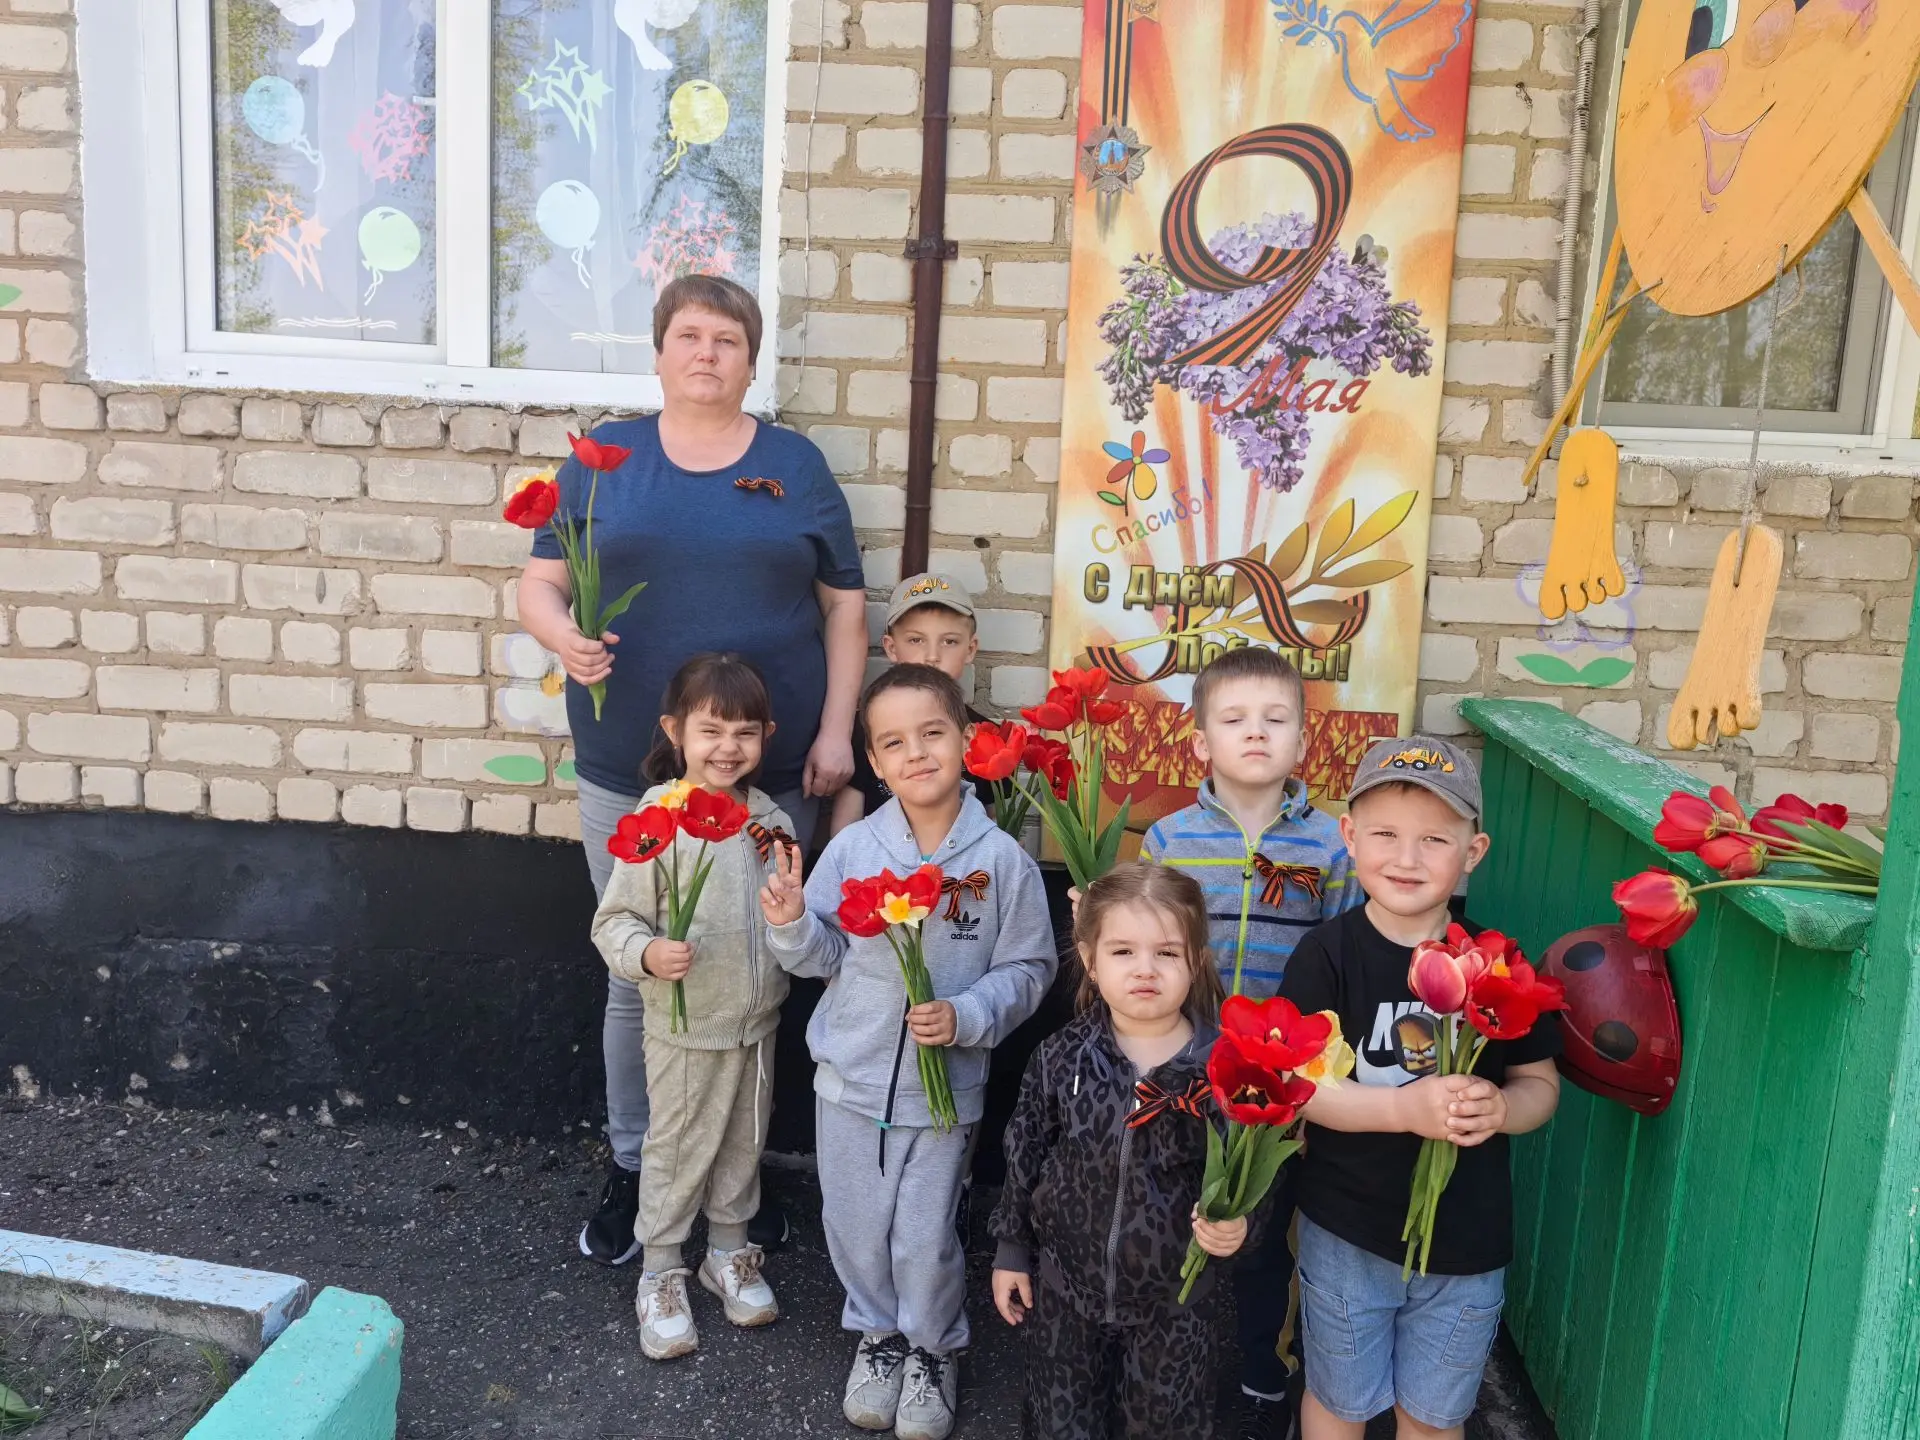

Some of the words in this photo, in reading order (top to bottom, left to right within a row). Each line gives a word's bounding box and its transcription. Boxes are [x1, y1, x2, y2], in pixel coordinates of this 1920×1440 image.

[1212, 354, 1371, 414] Мая
[1084, 562, 1110, 603] С
[1123, 565, 1234, 611] Днём
[1176, 635, 1351, 681] Поды!
[951, 932, 978, 940] adidas
